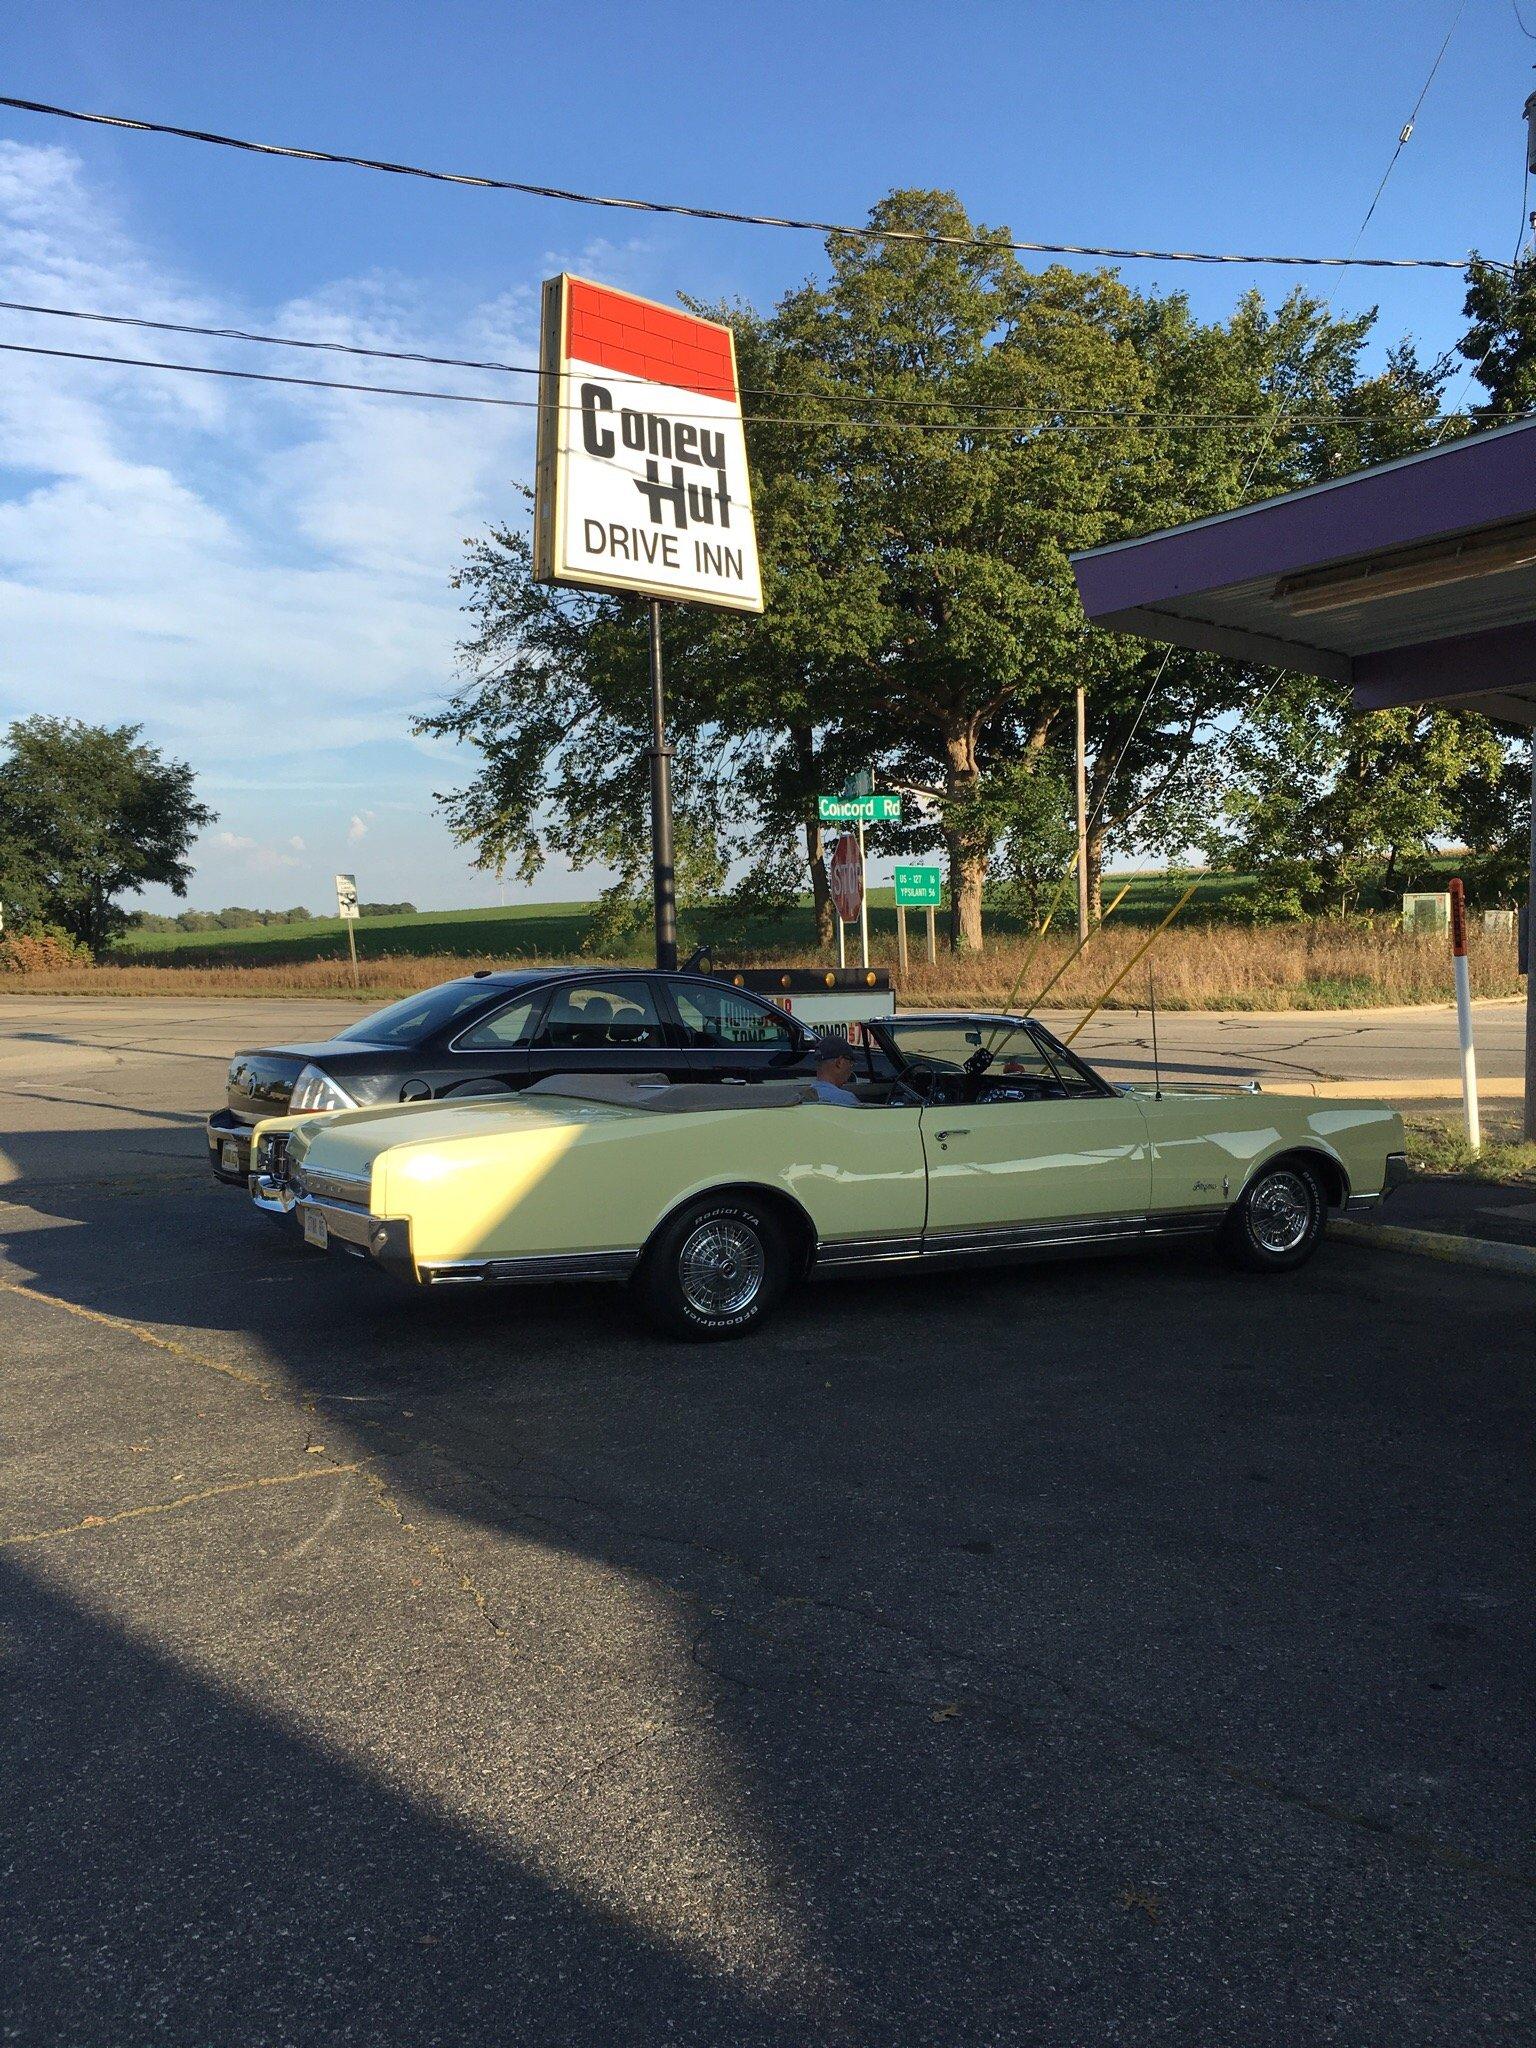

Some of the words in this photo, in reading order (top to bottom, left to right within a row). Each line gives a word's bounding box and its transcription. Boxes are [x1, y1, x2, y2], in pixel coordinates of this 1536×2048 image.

[580, 382, 726, 471] Coney
[632, 458, 732, 530] Hut
[583, 518, 681, 569] DRIVE
[694, 540, 744, 581] INN
[820, 799, 874, 817] Concord
[883, 799, 901, 817] Rd
[834, 863, 862, 896] STOP
[900, 887, 927, 897] YPSILANTI
[694, 1207, 738, 1226] Radial
[741, 1210, 761, 1227] T/A
[682, 1304, 760, 1328] BFGoodrich
